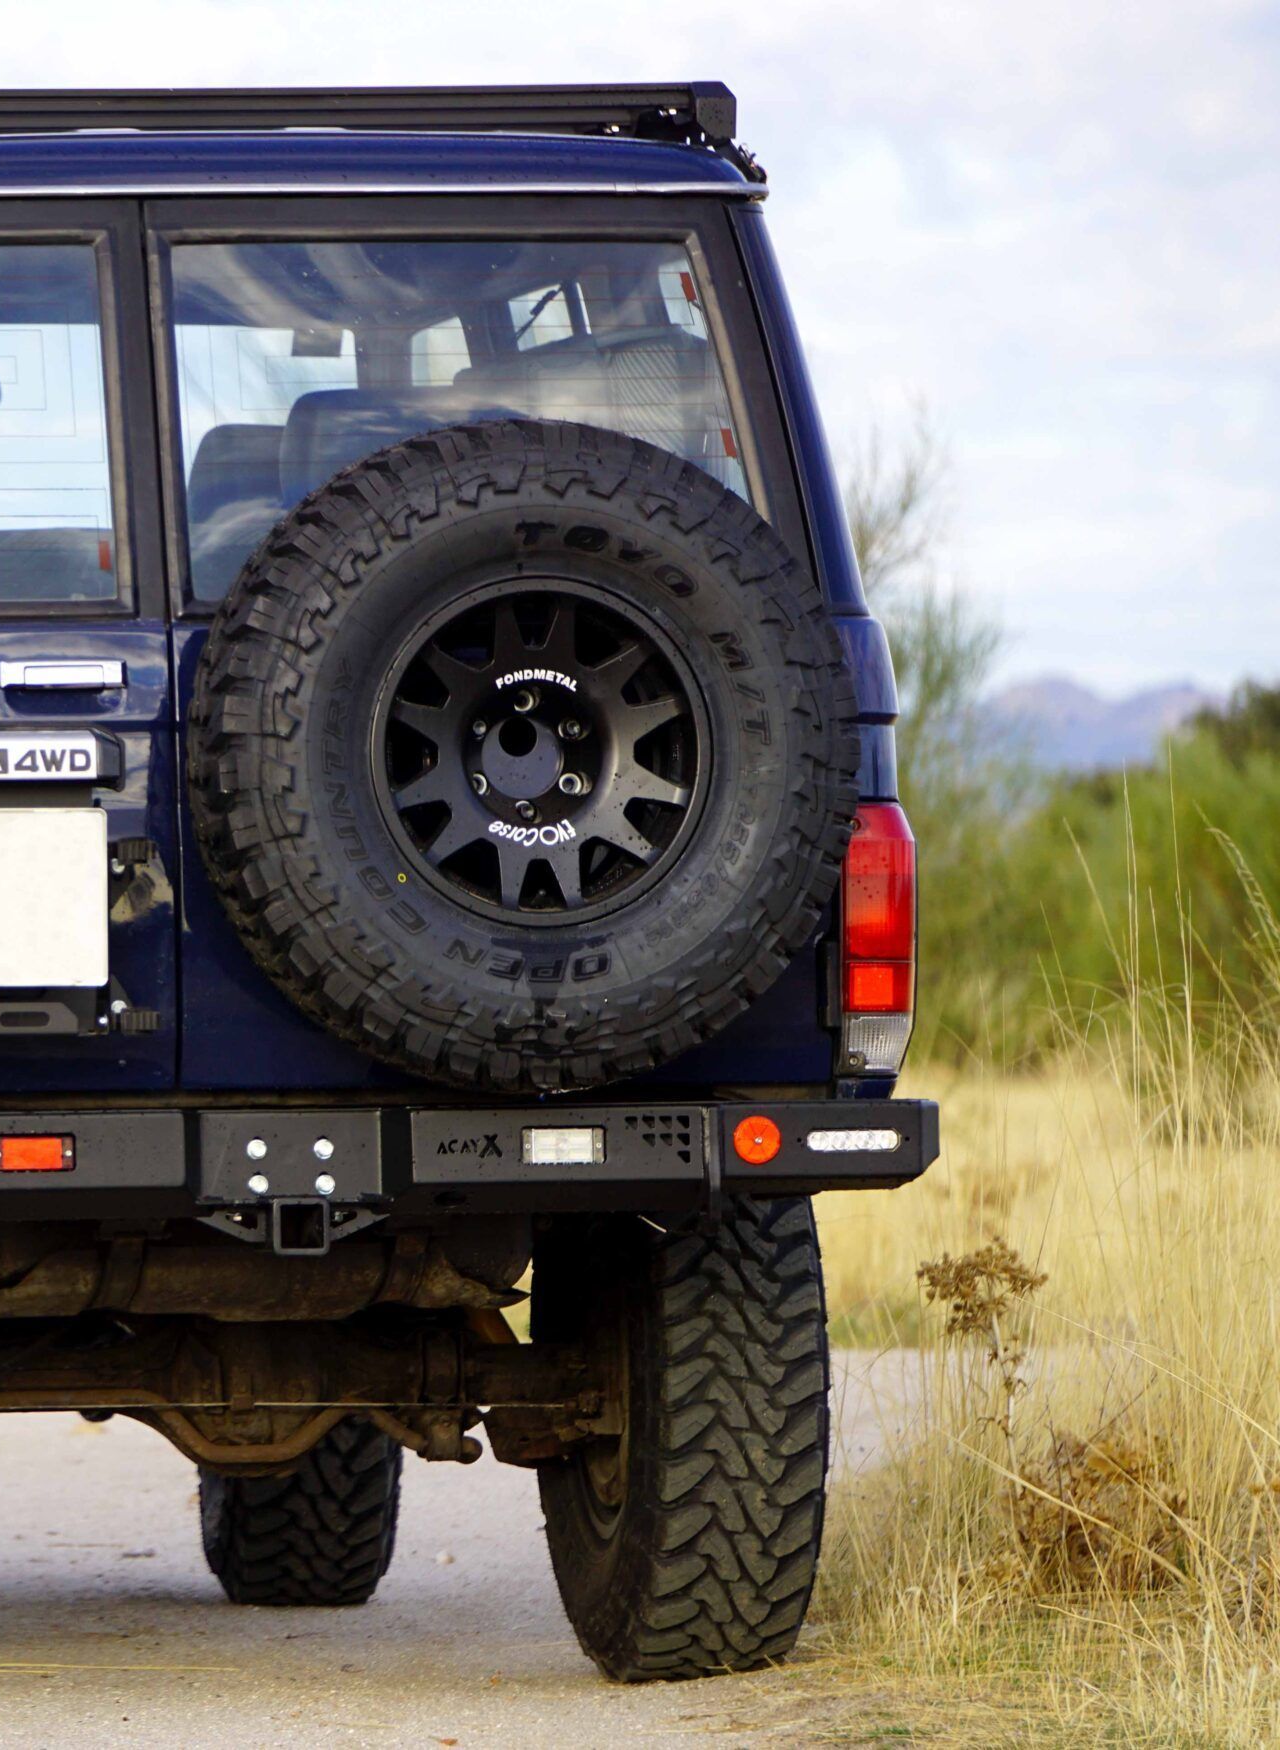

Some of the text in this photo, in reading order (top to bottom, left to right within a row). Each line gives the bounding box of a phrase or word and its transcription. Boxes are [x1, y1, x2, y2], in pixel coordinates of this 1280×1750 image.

[514, 520, 699, 599] TOYO
[495, 668, 578, 693] FONDMETAL
[706, 629, 772, 746] M/T
[14, 748, 92, 773] 4WD
[322, 656, 431, 936] COUNTRY
[442, 937, 613, 985] OPEN
